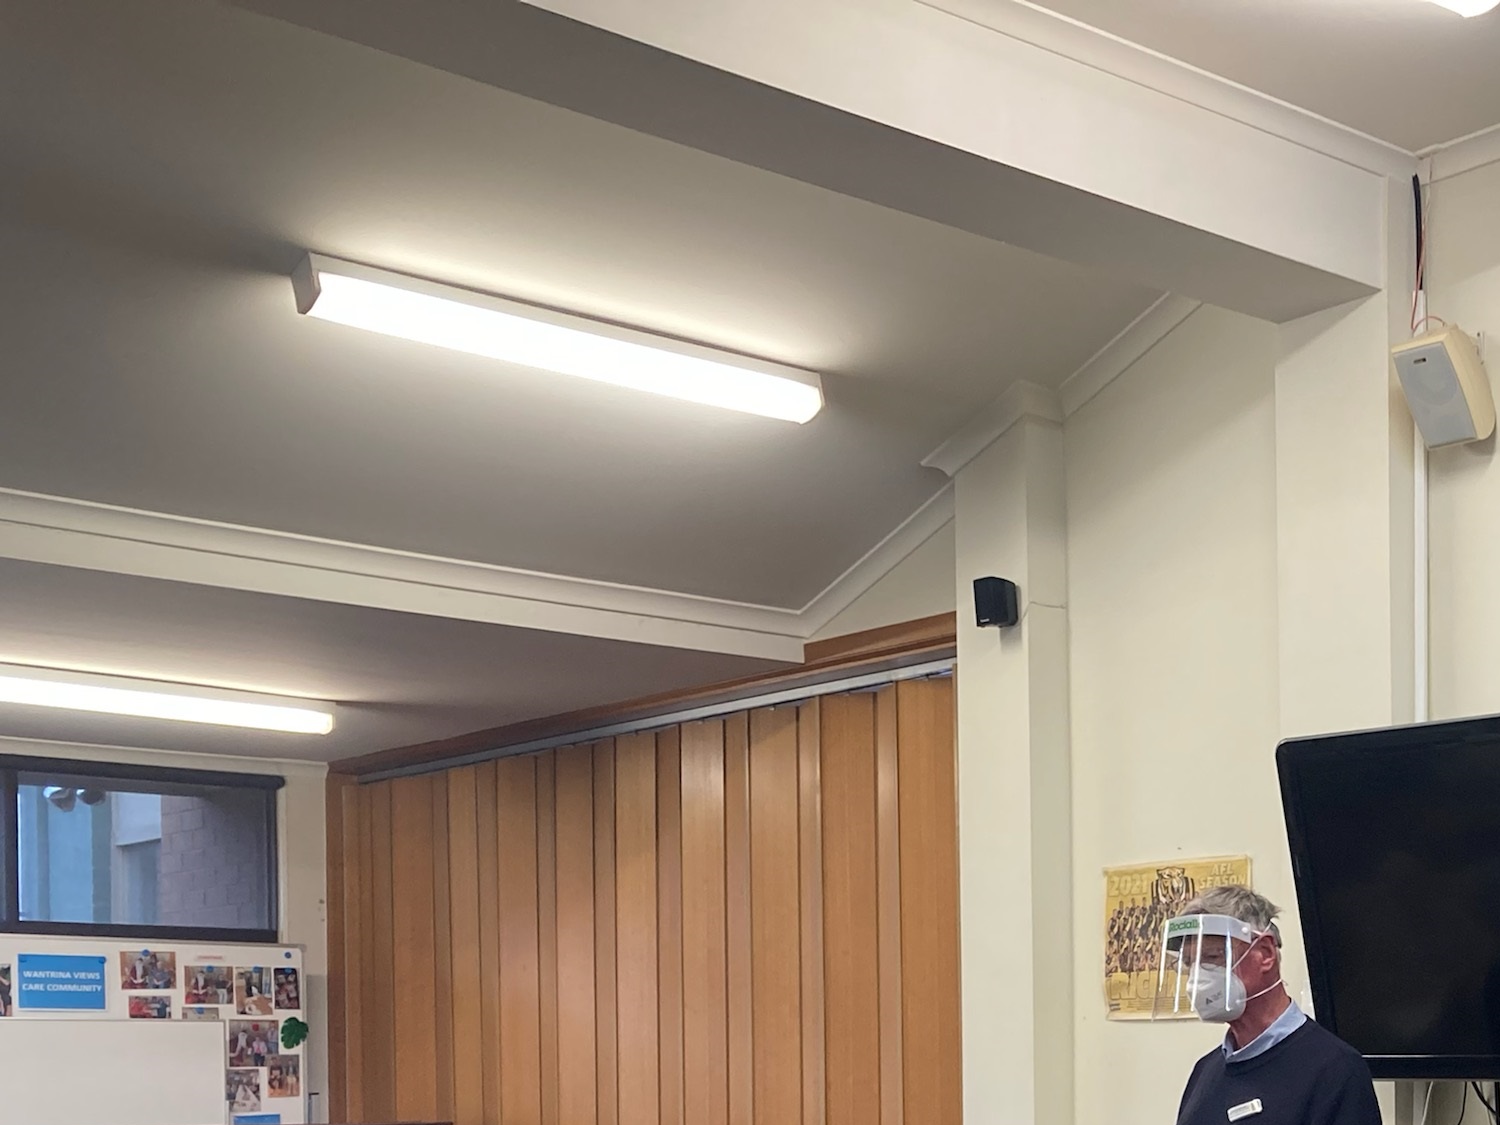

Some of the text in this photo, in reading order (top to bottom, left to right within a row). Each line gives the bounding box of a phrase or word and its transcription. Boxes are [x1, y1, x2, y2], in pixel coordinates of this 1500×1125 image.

[1210, 863, 1234, 876] AFL
[1109, 874, 1148, 897] 2021
[1199, 874, 1247, 889] SEASON
[73, 972, 101, 980] VIEWS
[22, 983, 102, 992] CARE COMMUNITY
